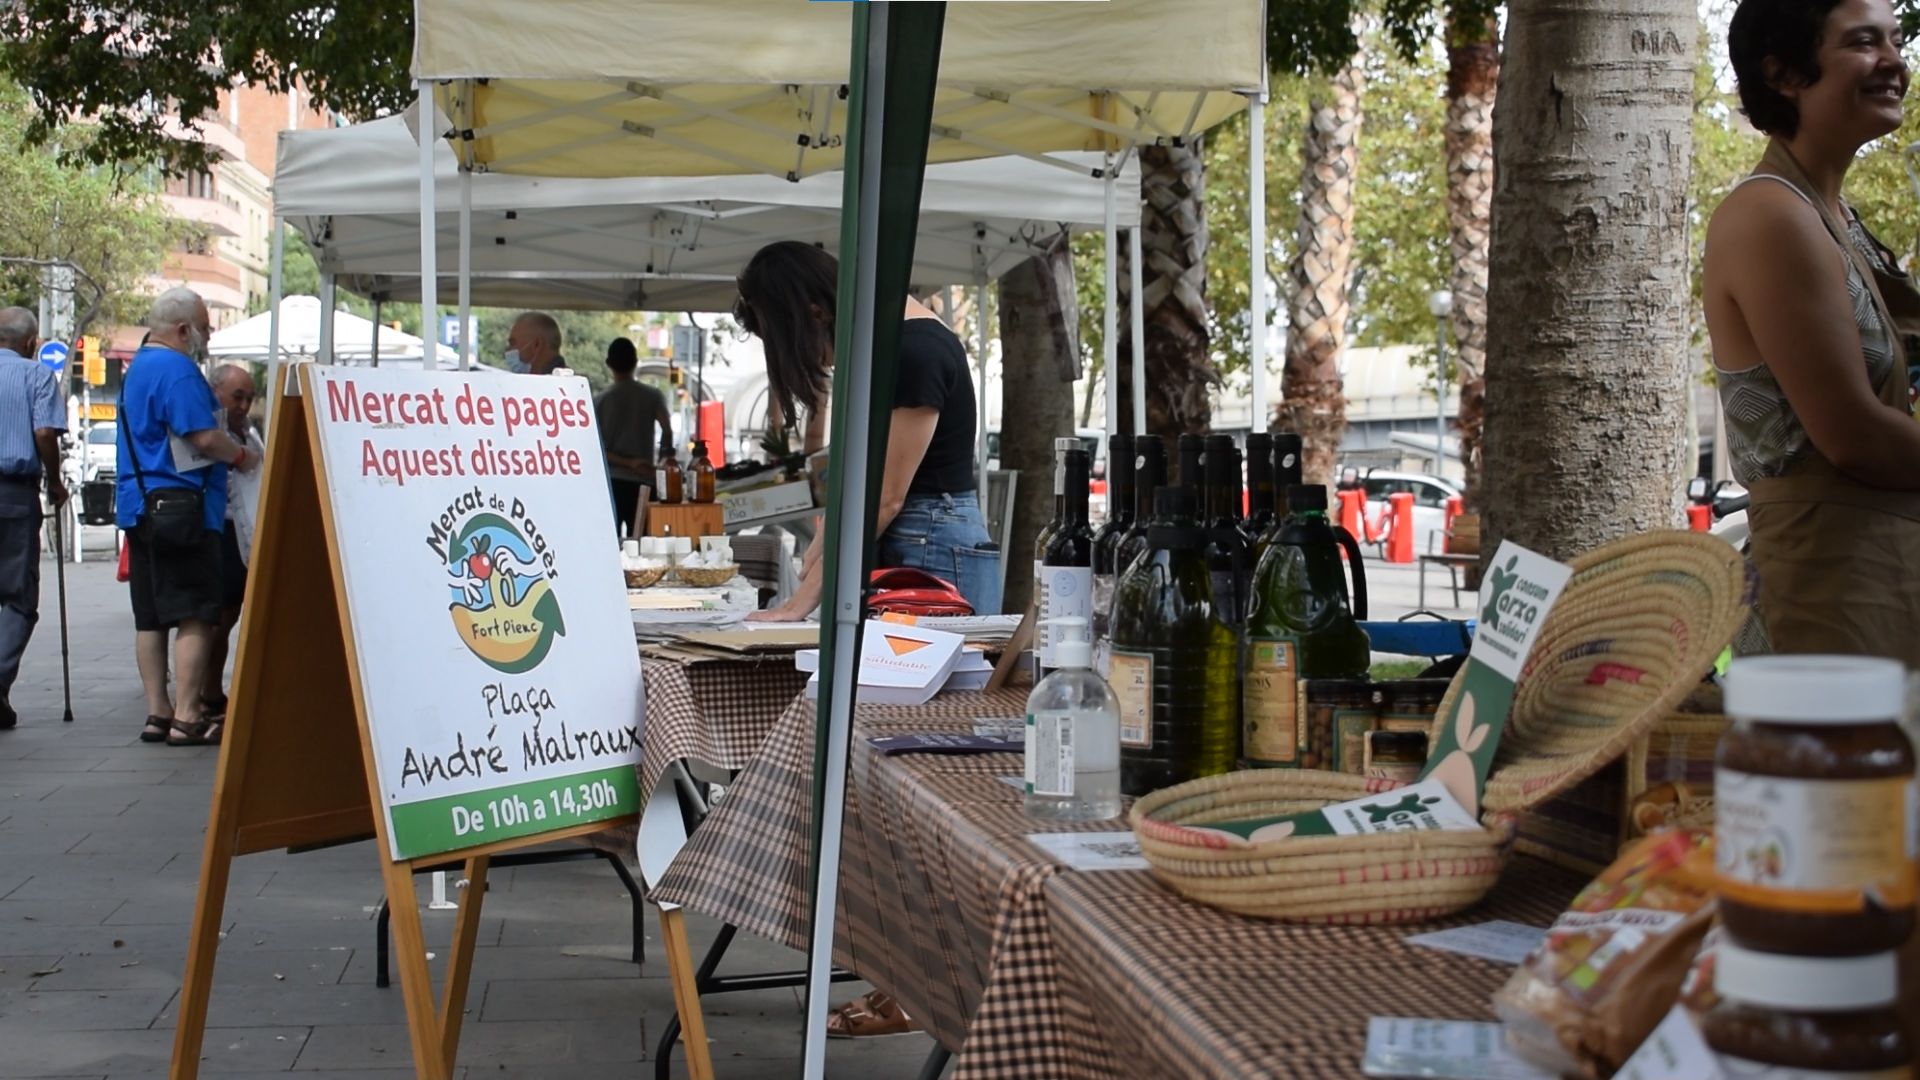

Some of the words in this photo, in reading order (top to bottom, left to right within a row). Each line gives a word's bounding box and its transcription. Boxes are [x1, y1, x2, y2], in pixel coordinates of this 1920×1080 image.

[326, 379, 447, 425] Mercat
[455, 383, 495, 426] de
[501, 387, 590, 438] pagès
[361, 439, 465, 487] Aquest
[470, 439, 582, 477] dissabte
[426, 485, 484, 565] Mercat
[489, 493, 505, 512] de
[471, 621, 501, 640] Fort
[481, 682, 556, 728] Plaça
[401, 724, 508, 788] André
[522, 720, 644, 771] Malraux
[451, 806, 485, 836] De
[488, 797, 530, 828] 10h
[533, 799, 547, 820] a
[550, 778, 619, 817] 14,30h
